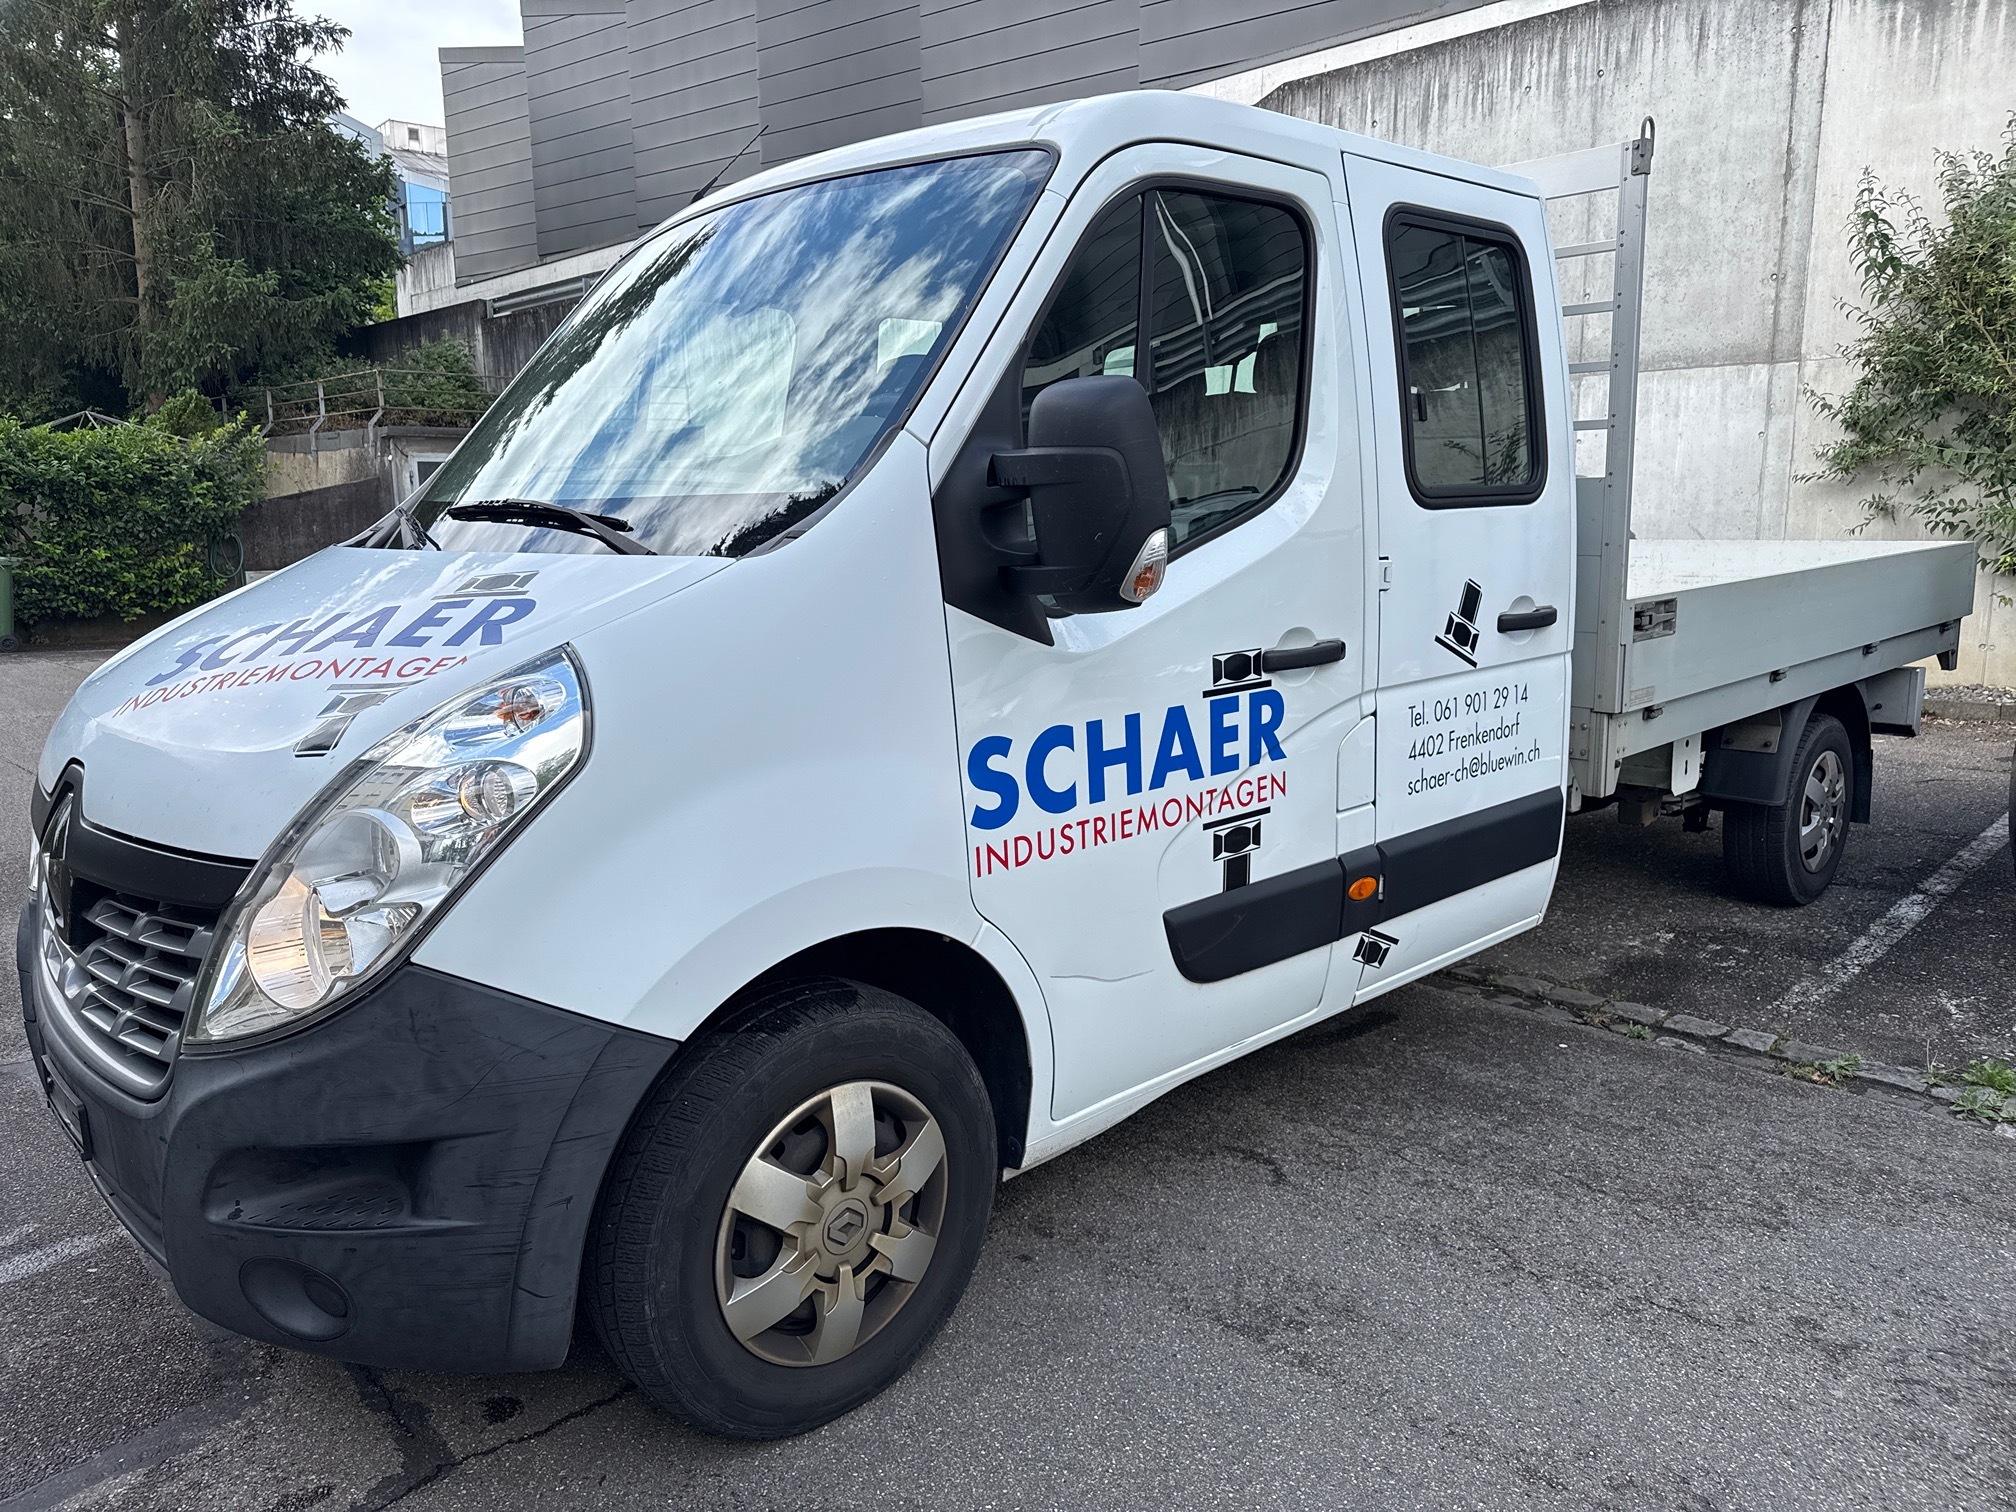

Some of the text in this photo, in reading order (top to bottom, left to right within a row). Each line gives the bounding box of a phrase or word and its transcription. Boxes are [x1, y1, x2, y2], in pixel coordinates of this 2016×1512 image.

[145, 599, 536, 686] SCHAER
[1408, 683, 1528, 728] Tel. 061 901 29 14
[1408, 712, 1520, 761] 4402 Frenkendorf
[967, 689, 1287, 830] SCHAER
[1407, 738, 1540, 795] schaer-ch@bluewin.ch
[975, 771, 1287, 878] INDUSTRIEMONTAGEN
